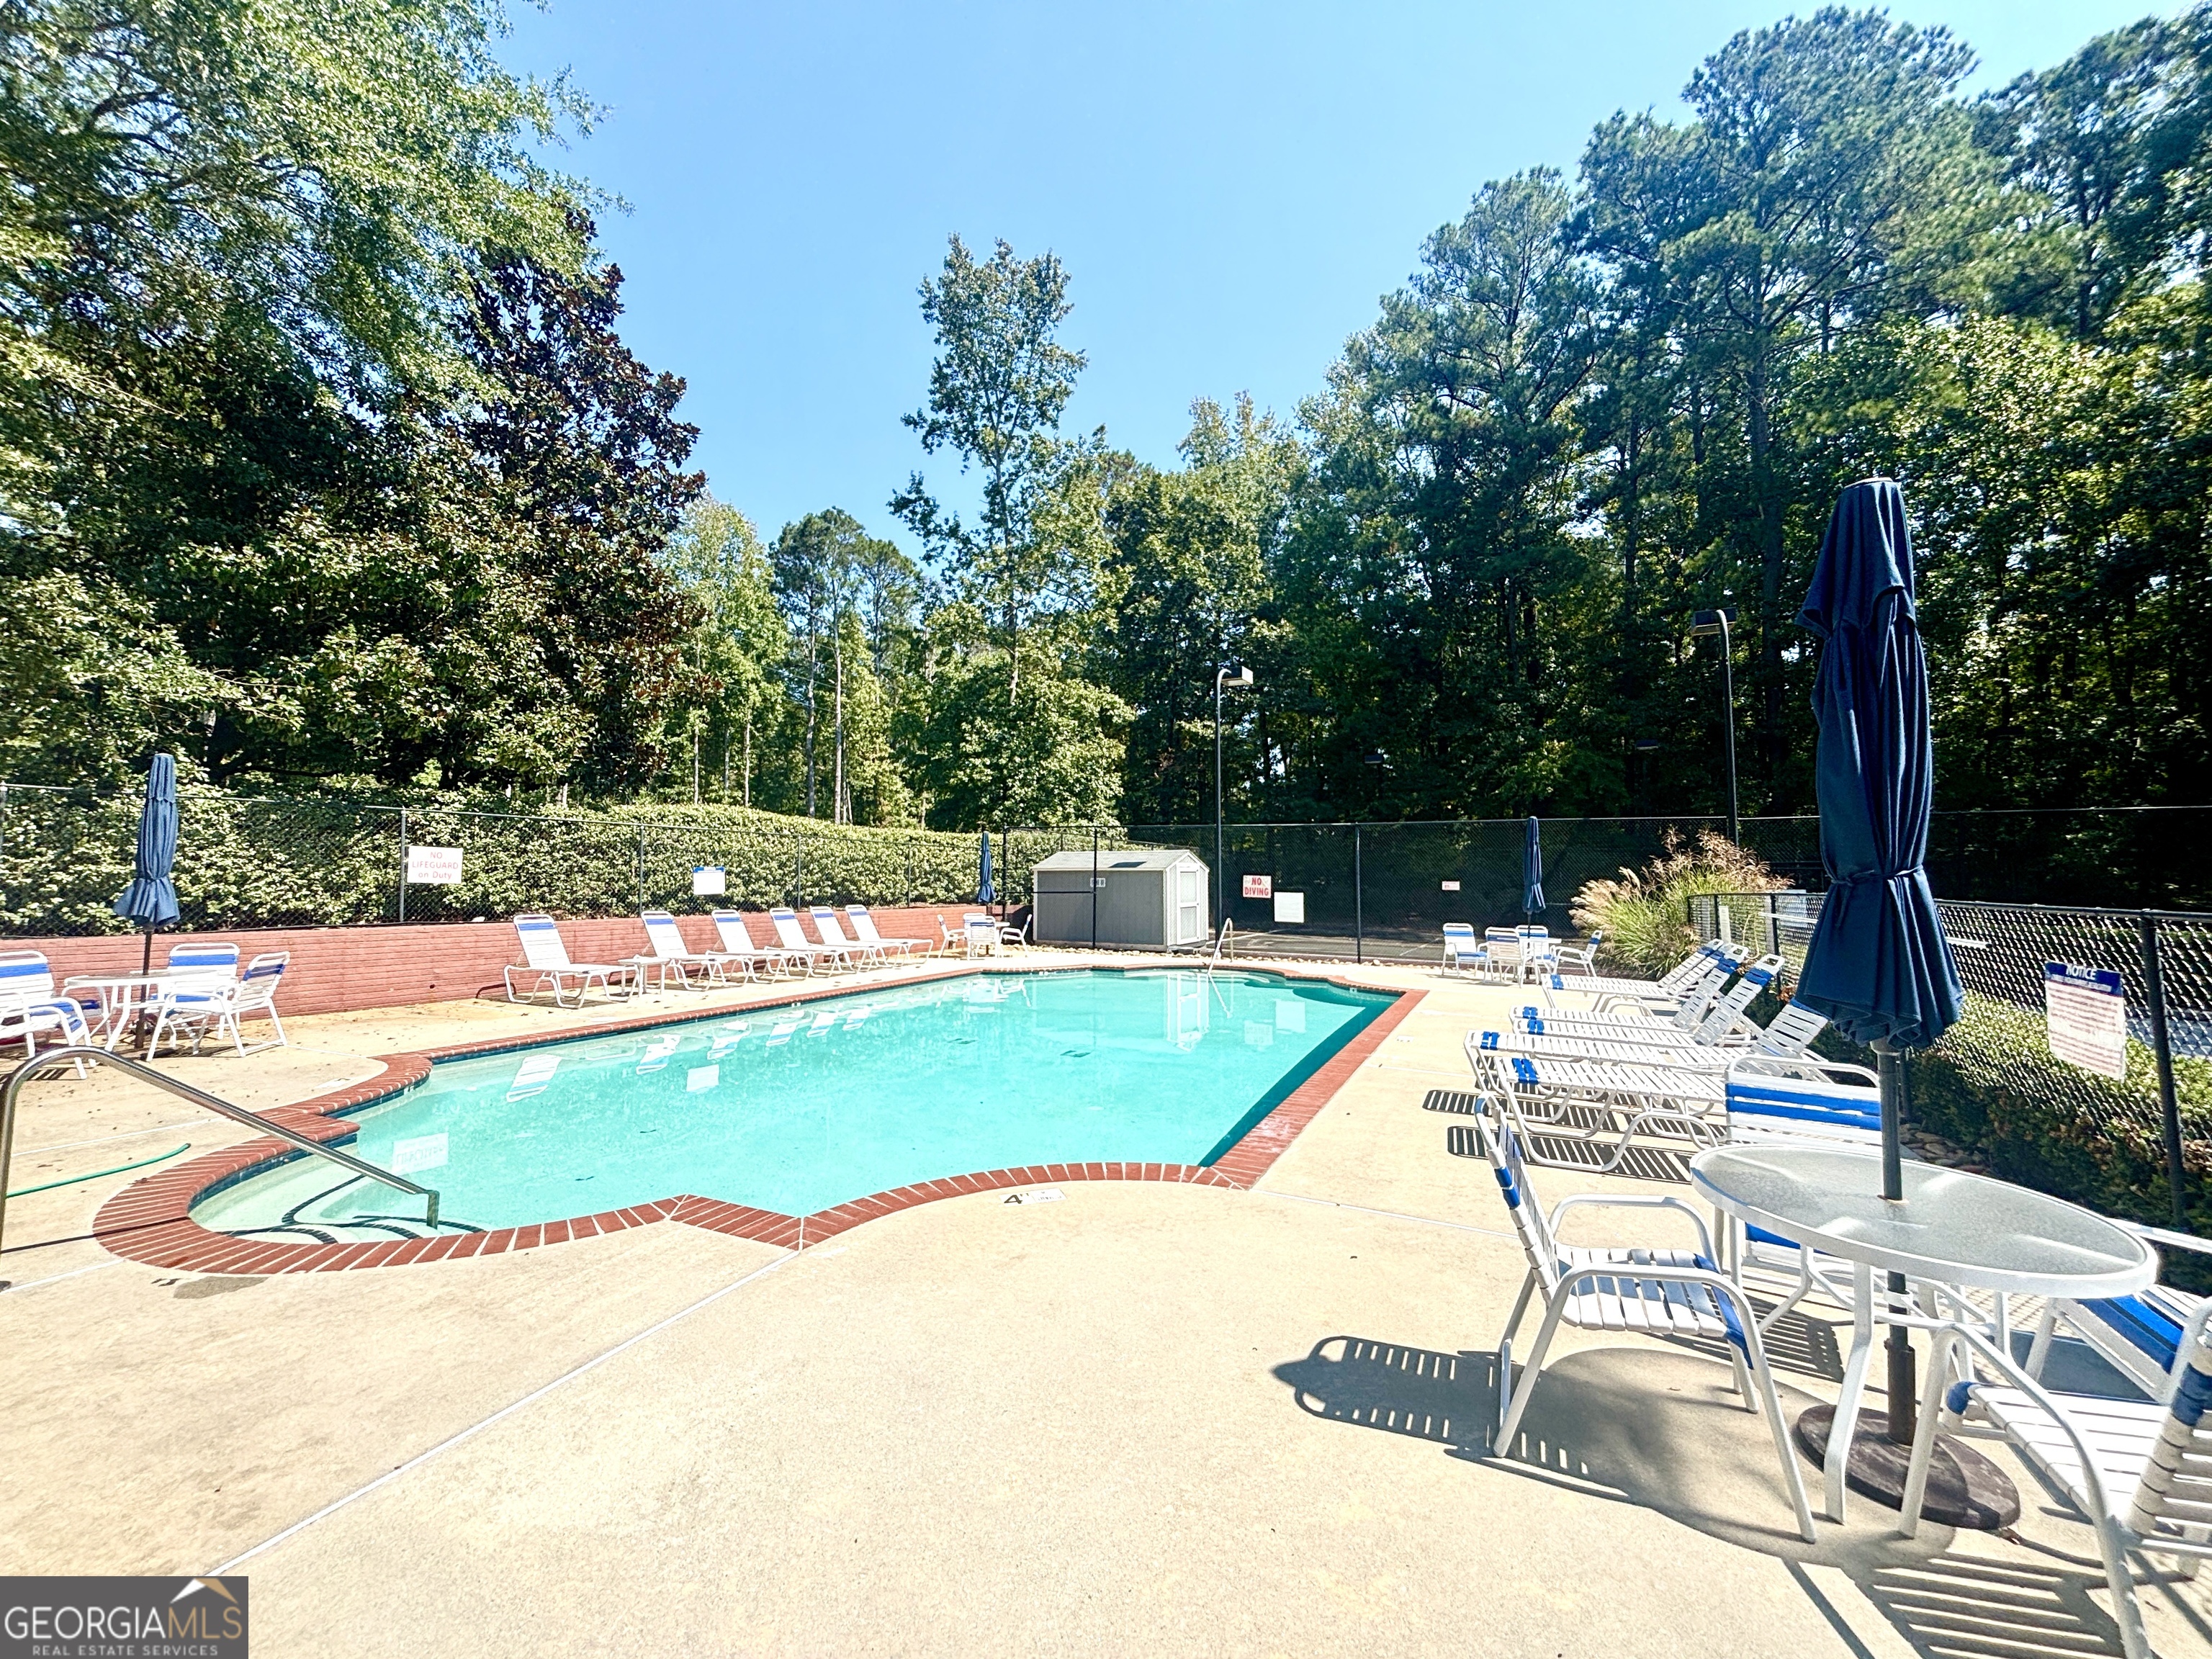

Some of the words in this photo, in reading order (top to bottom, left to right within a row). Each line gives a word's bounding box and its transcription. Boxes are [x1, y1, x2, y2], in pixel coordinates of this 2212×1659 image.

[412, 860, 459, 870] LIFEGUARD
[432, 871, 452, 881] Duty
[1251, 877, 1262, 886] NO
[1244, 886, 1269, 896] DIVING
[2066, 965, 2098, 980] NOTICE
